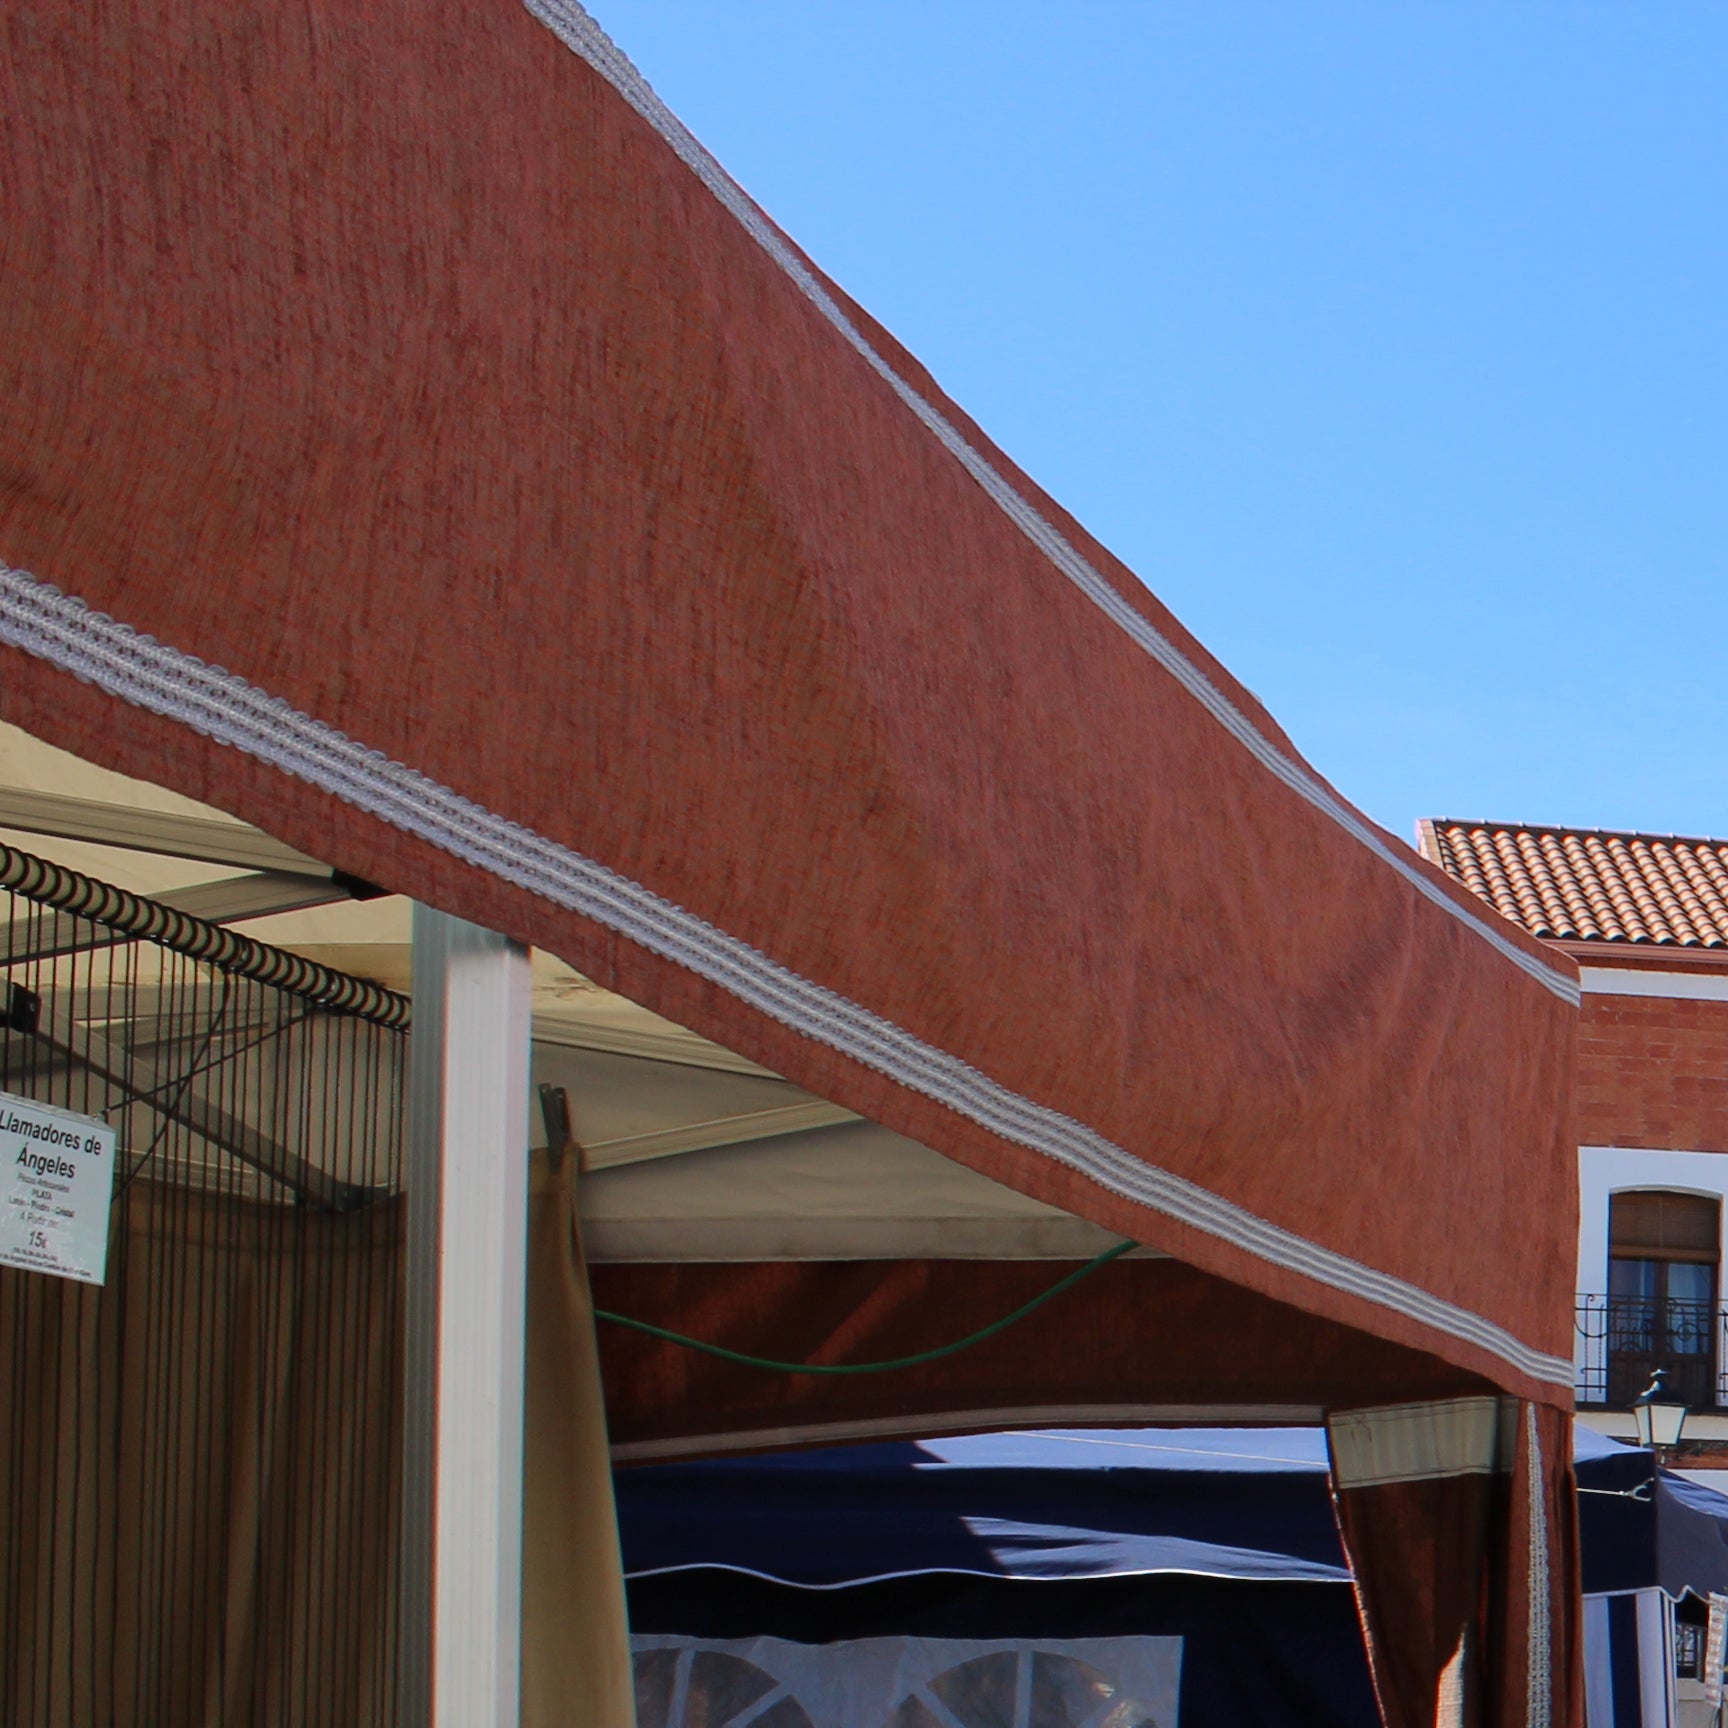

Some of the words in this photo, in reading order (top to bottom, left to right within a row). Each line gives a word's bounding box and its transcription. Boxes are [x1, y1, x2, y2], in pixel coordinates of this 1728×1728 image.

[0, 1110, 81, 1150] Llamadores
[84, 1136, 102, 1156] de
[16, 1142, 77, 1179] Ángeles
